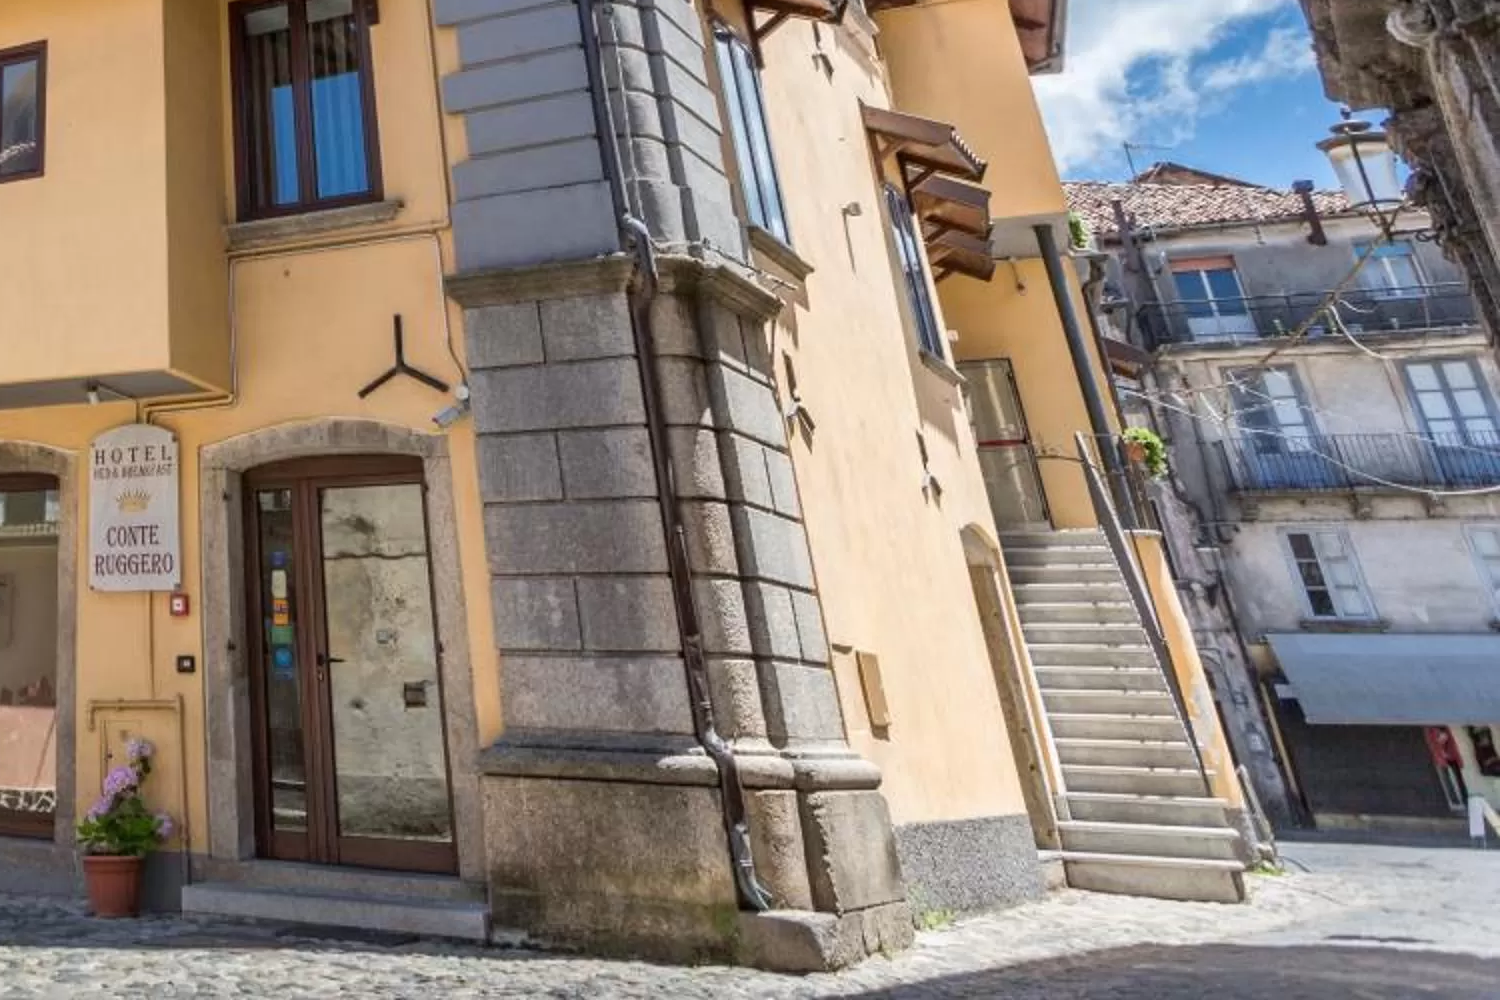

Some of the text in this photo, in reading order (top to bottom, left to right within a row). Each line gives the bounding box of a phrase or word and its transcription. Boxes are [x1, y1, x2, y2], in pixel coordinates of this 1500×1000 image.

[95, 444, 172, 465] HOTEL
[107, 524, 160, 547] CONTE
[95, 552, 174, 576] RUGGERO
